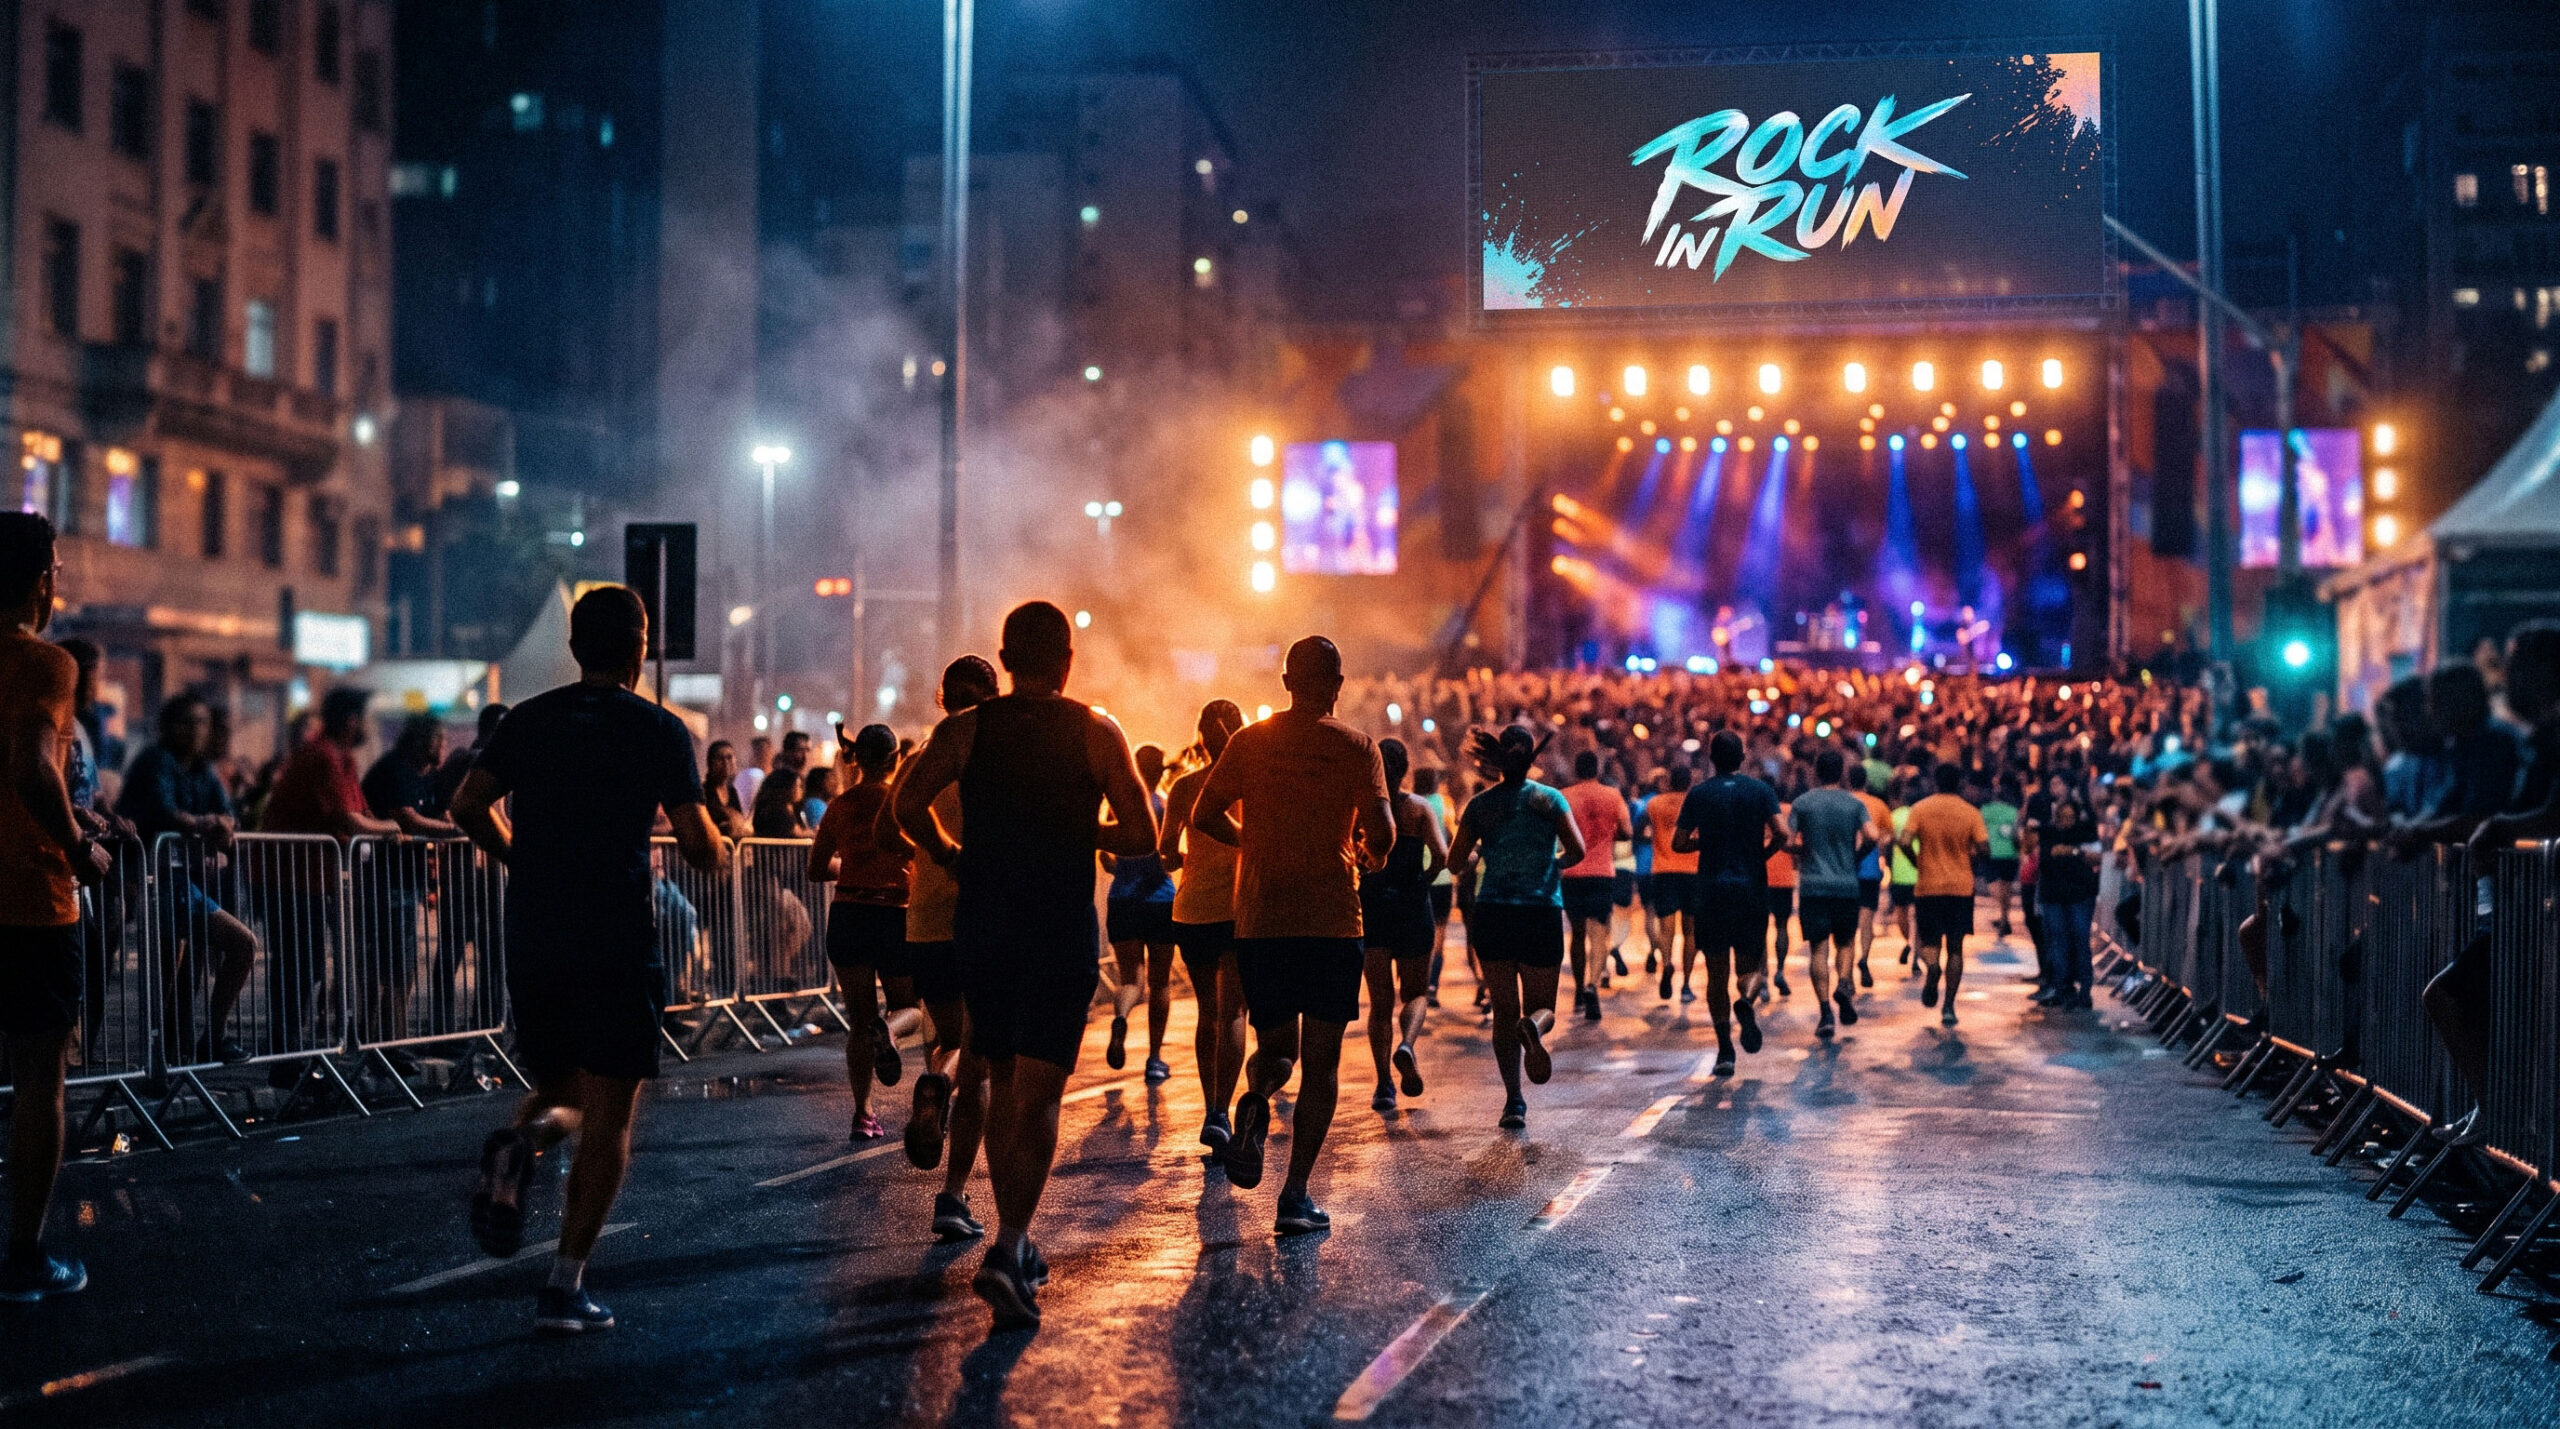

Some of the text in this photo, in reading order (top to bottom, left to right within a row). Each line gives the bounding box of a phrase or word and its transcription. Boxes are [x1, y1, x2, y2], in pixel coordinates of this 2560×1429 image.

[1630, 93, 1972, 246] ROCK
[1654, 168, 1917, 283] IN RUN
